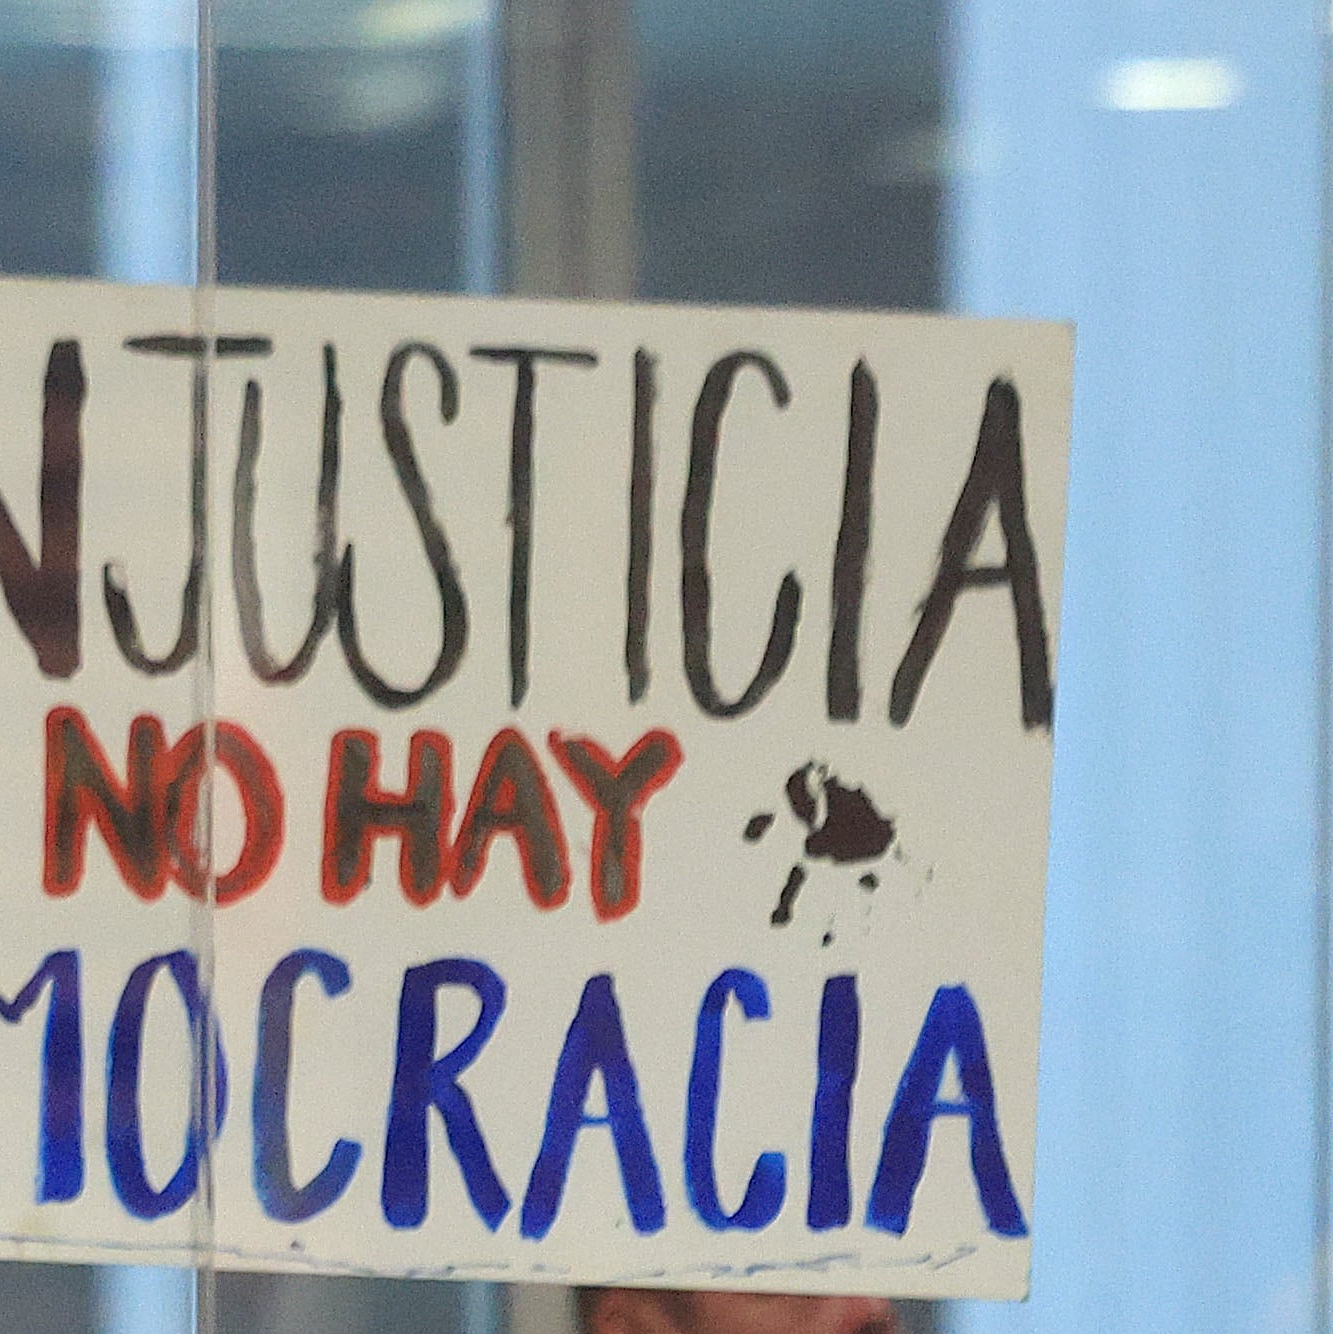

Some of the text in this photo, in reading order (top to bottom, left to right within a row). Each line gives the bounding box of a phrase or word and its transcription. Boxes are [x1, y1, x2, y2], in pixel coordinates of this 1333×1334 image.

[103, 335, 1054, 733] JUSTICIA
[42, 705, 684, 922] NO HAY
